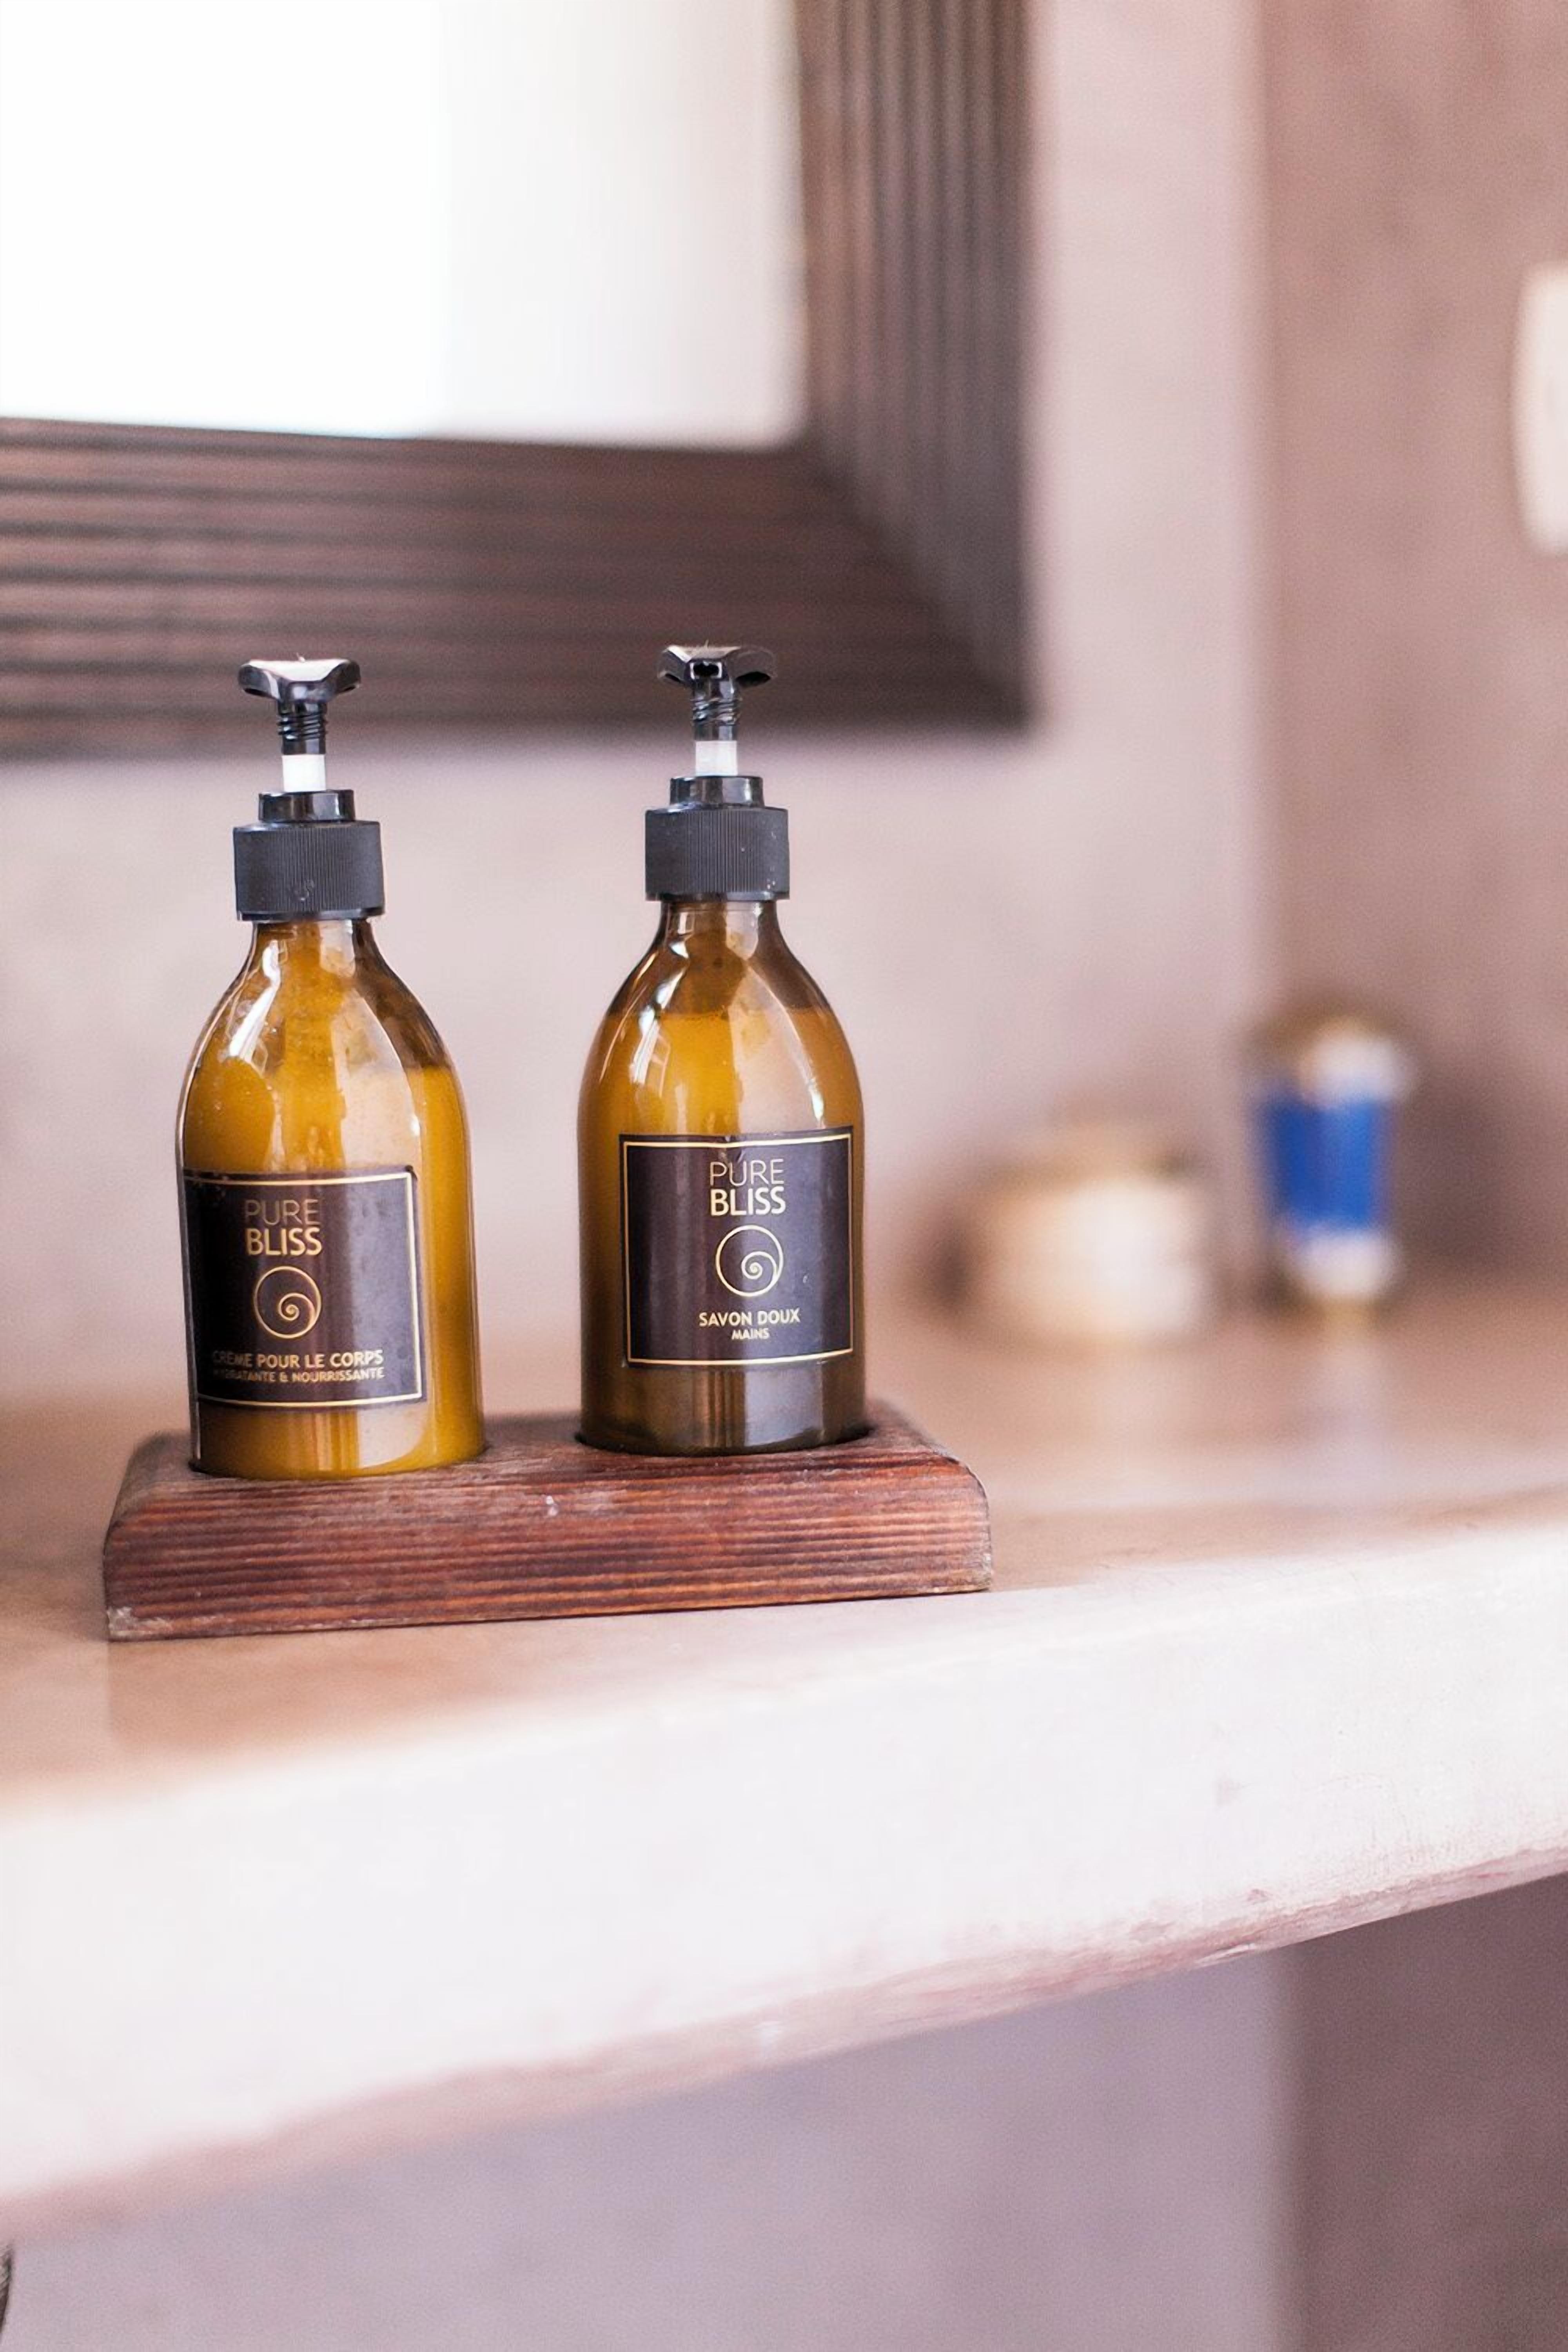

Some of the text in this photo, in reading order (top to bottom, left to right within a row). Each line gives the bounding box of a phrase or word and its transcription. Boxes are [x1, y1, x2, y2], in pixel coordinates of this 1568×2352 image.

[710, 1158, 784, 1187] PURE
[244, 1199, 320, 1226] PURE
[710, 1186, 786, 1216] BLISS
[245, 1227, 323, 1256] BLISS
[699, 1307, 800, 1327] SAVON DOUX
[731, 1328, 770, 1340] MAINS
[257, 1353, 299, 1368] POUR
[305, 1353, 325, 1368] LE
[330, 1350, 383, 1368] CORPS
[279, 1372, 289, 1383] &
[292, 1367, 385, 1383] NOURRISSANTE
